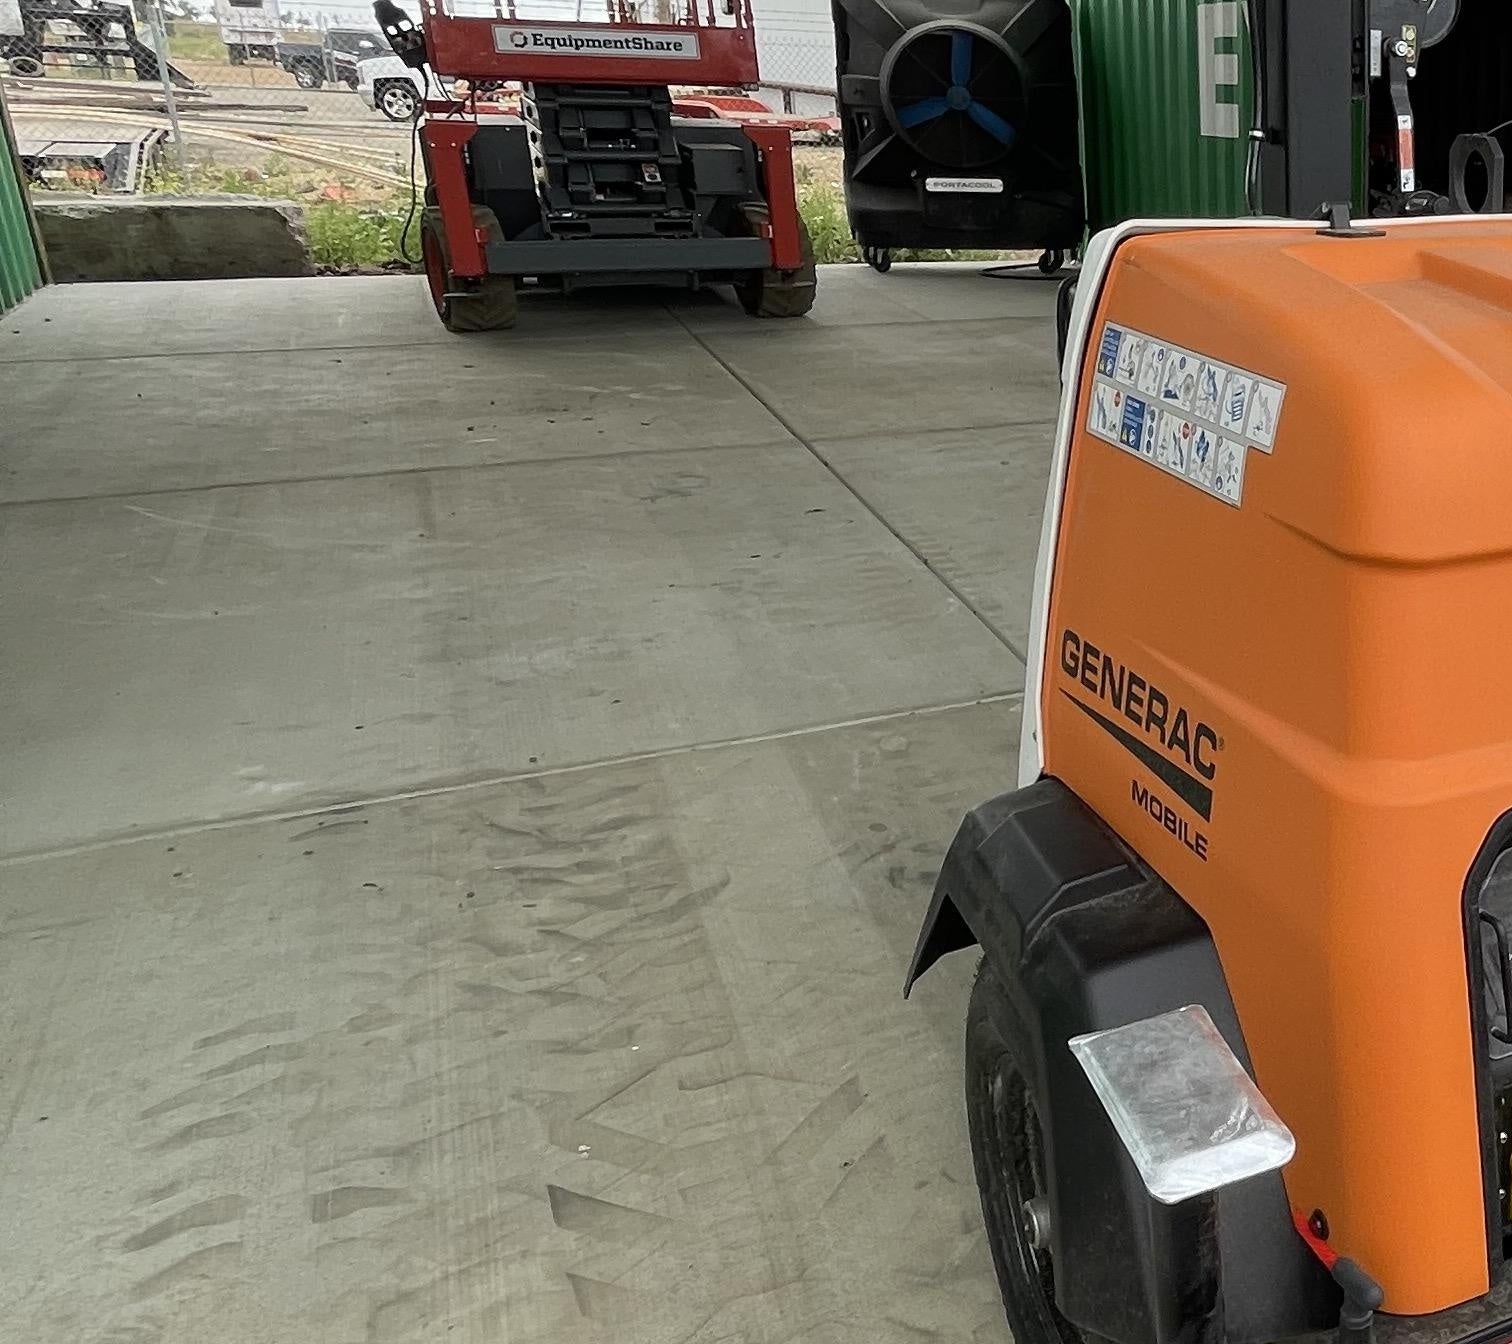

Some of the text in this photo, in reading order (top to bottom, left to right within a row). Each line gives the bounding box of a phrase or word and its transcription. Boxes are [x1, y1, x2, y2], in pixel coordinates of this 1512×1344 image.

[531, 33, 683, 52] EquipmentShare
[1198, 1, 1250, 138] E
[933, 181, 997, 189] PORTACOOL
[1061, 629, 1219, 781] GENERAC
[1132, 779, 1208, 862] MOBILE
